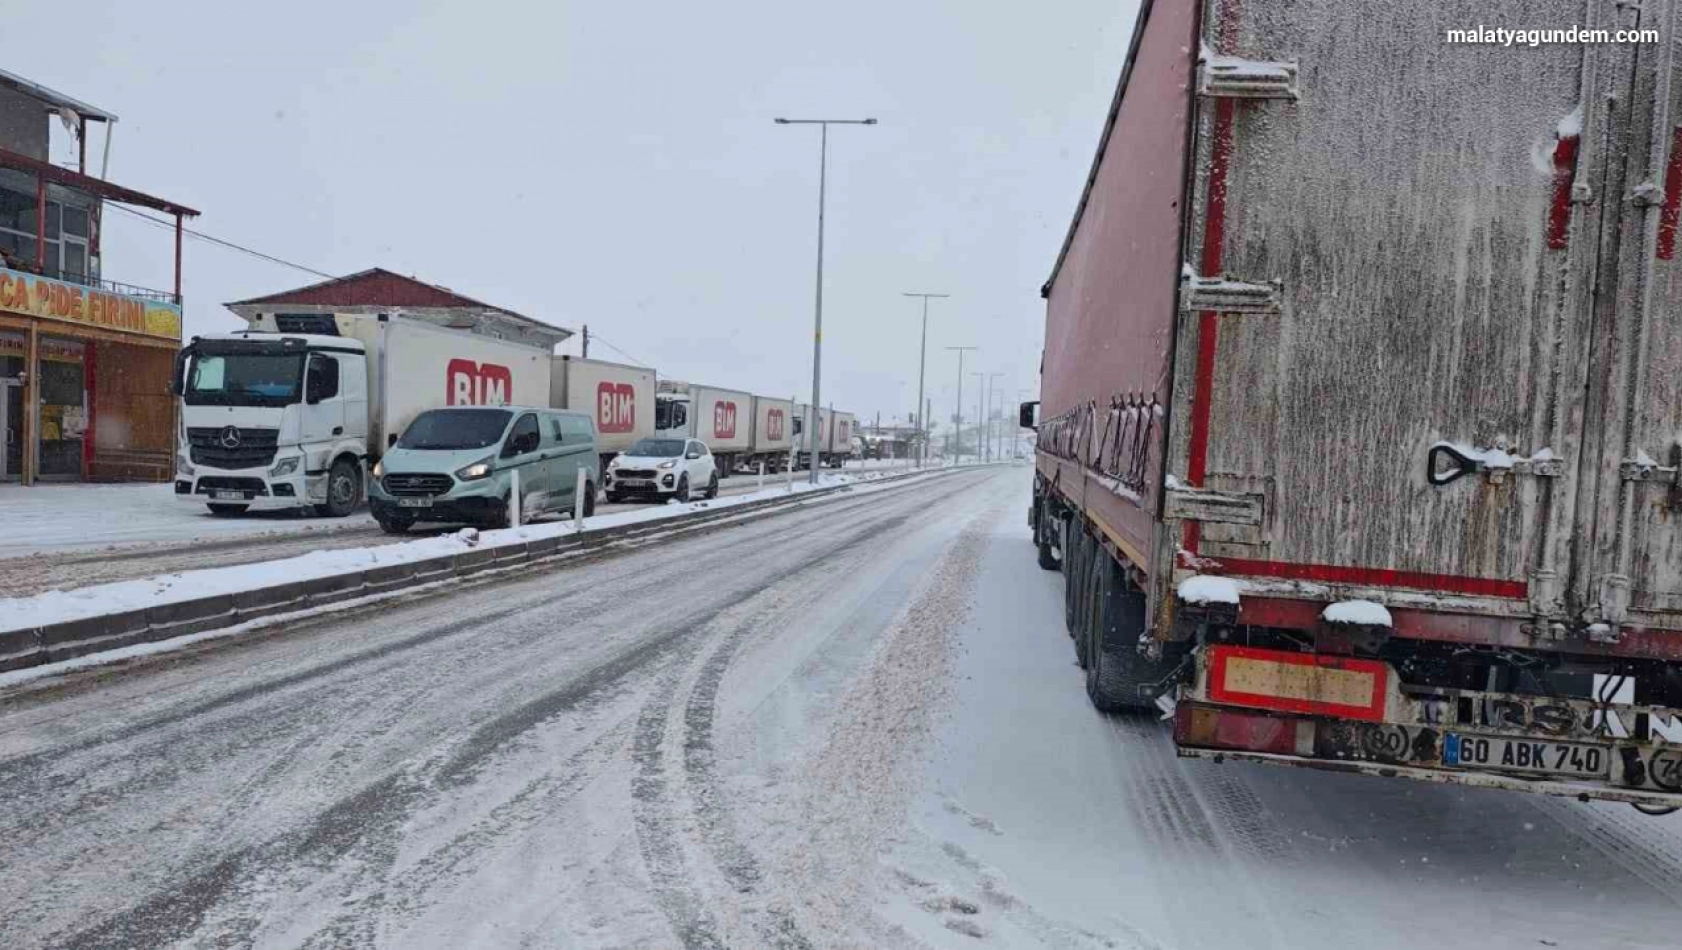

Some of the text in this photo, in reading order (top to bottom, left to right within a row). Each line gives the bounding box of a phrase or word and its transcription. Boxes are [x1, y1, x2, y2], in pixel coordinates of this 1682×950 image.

[454, 371, 505, 406] BIM
[601, 392, 632, 425] BIM
[715, 407, 735, 434] BIM
[1371, 730, 1401, 752] 80
[1460, 738, 1489, 763] 60
[1502, 741, 1546, 769] ABK
[1555, 745, 1600, 773] 740
